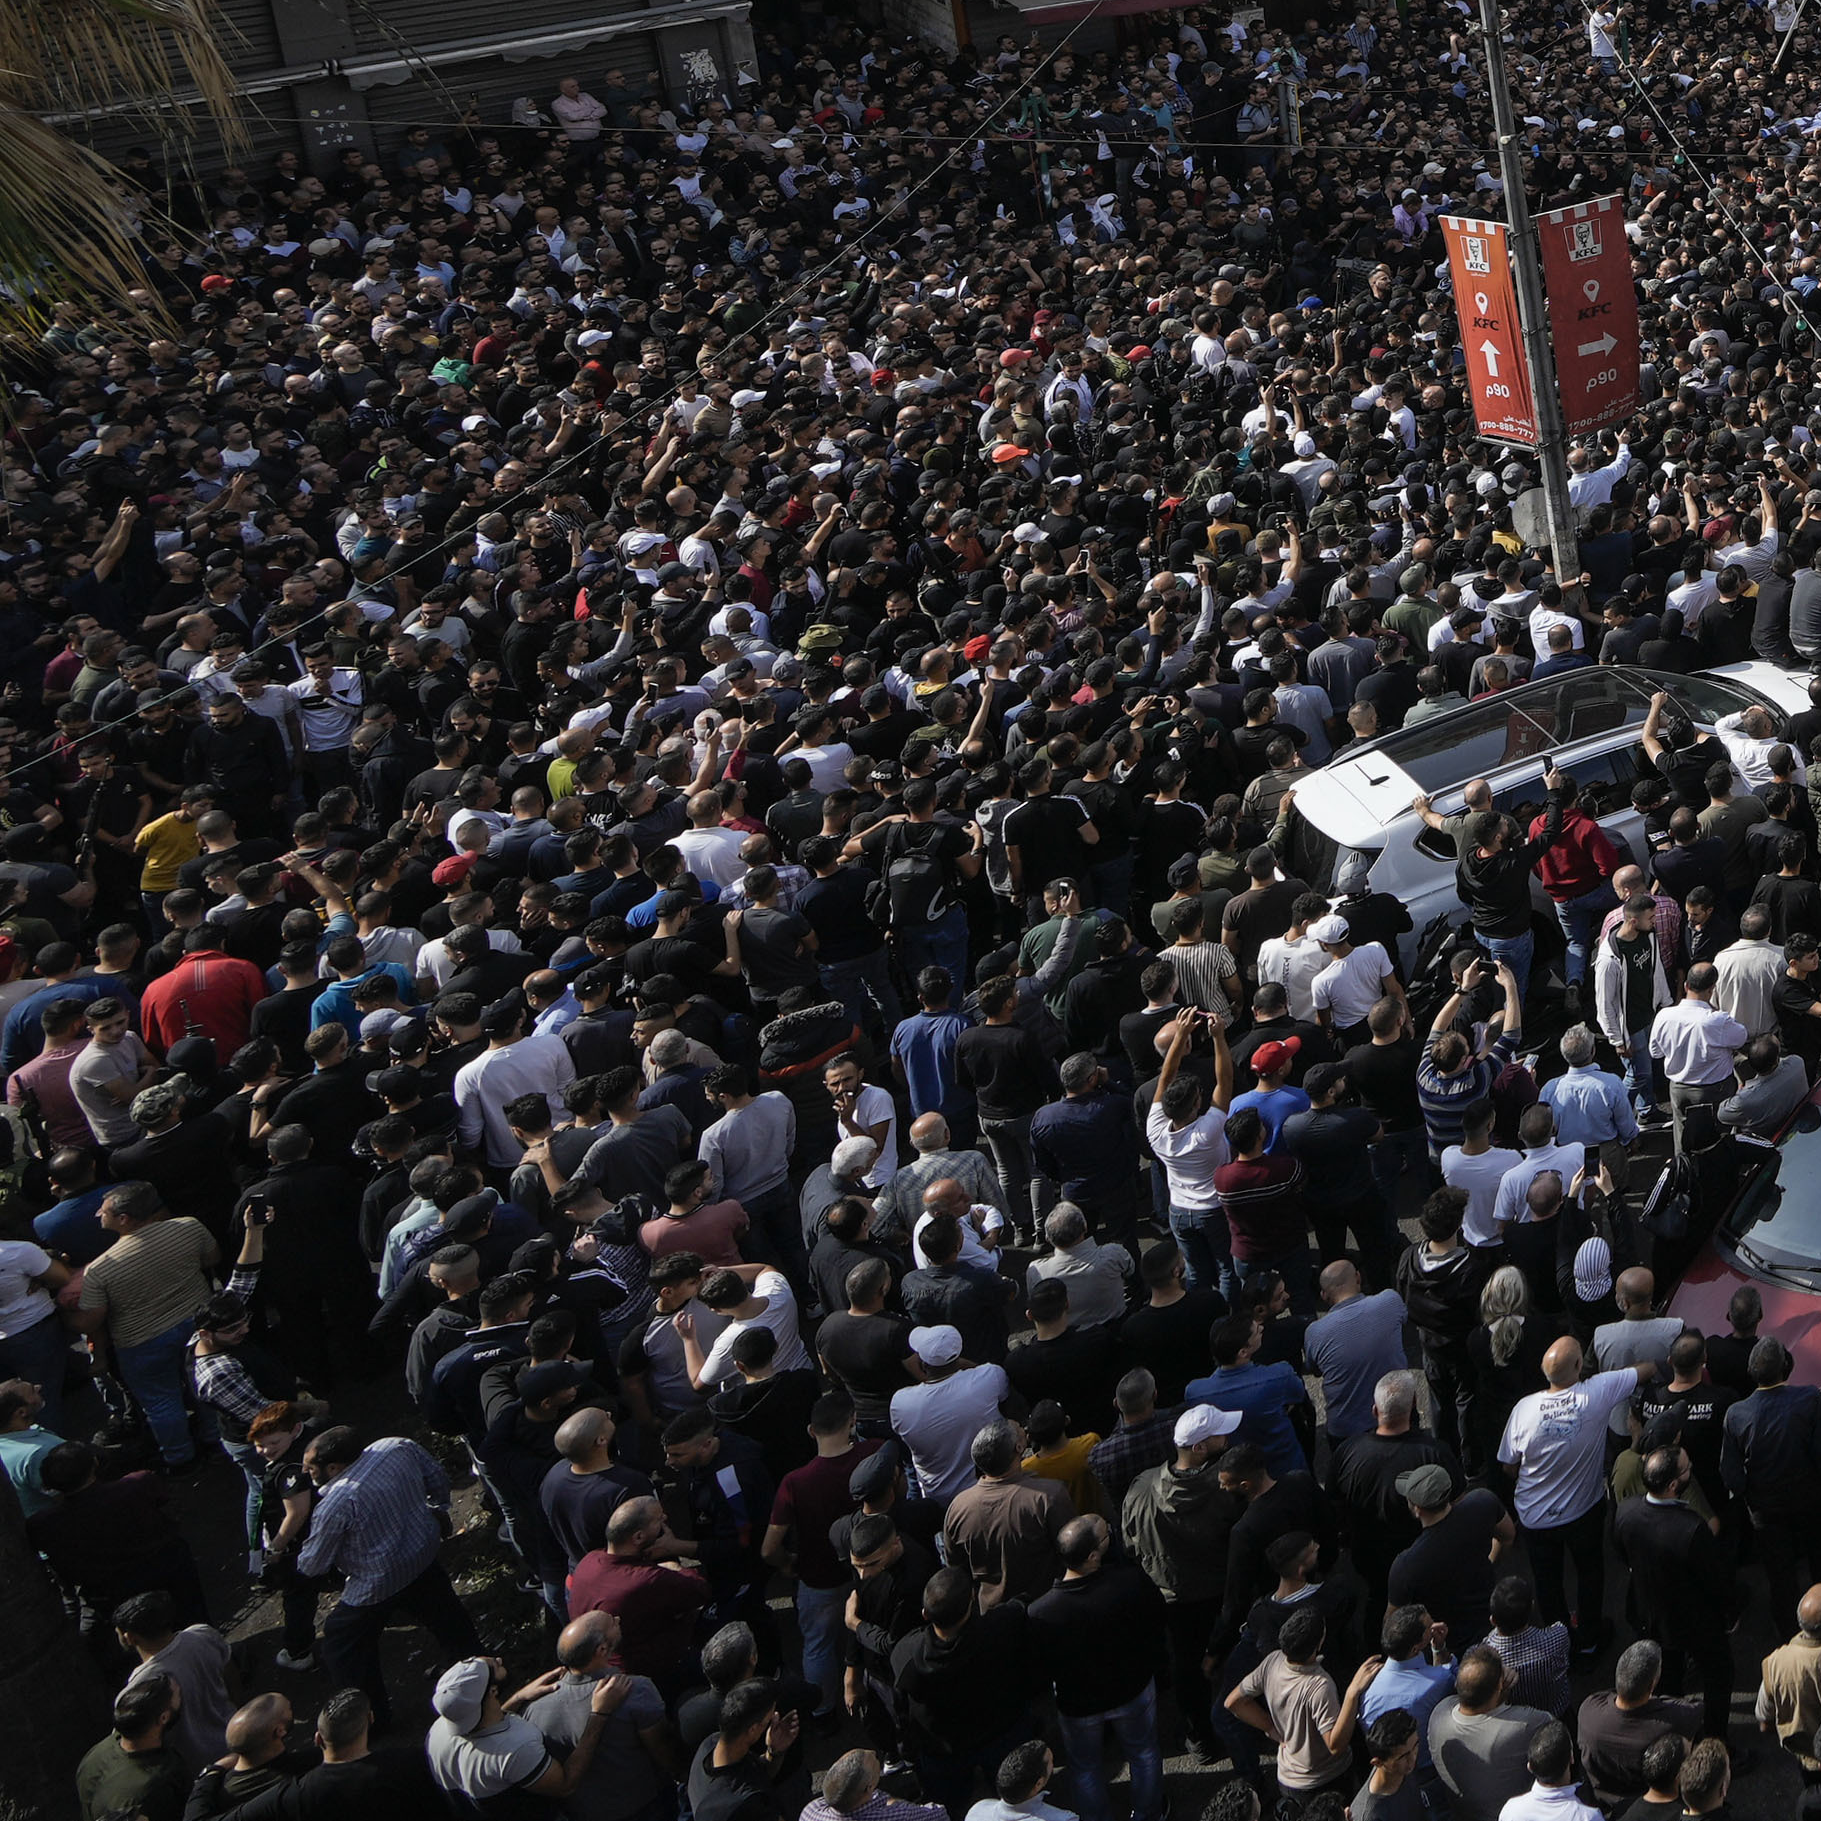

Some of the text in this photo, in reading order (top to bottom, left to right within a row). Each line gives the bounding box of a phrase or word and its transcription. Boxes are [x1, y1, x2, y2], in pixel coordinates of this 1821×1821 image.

[1575, 246, 1599, 260] KFC
[1469, 261, 1487, 272] KFC
[1577, 301, 1613, 322] KFC
[1472, 316, 1500, 332] KFC
[1479, 420, 1536, 440] 1700-888-777
[473, 1347, 501, 1362] SPORT
[1643, 1401, 1664, 1414] PAUL
